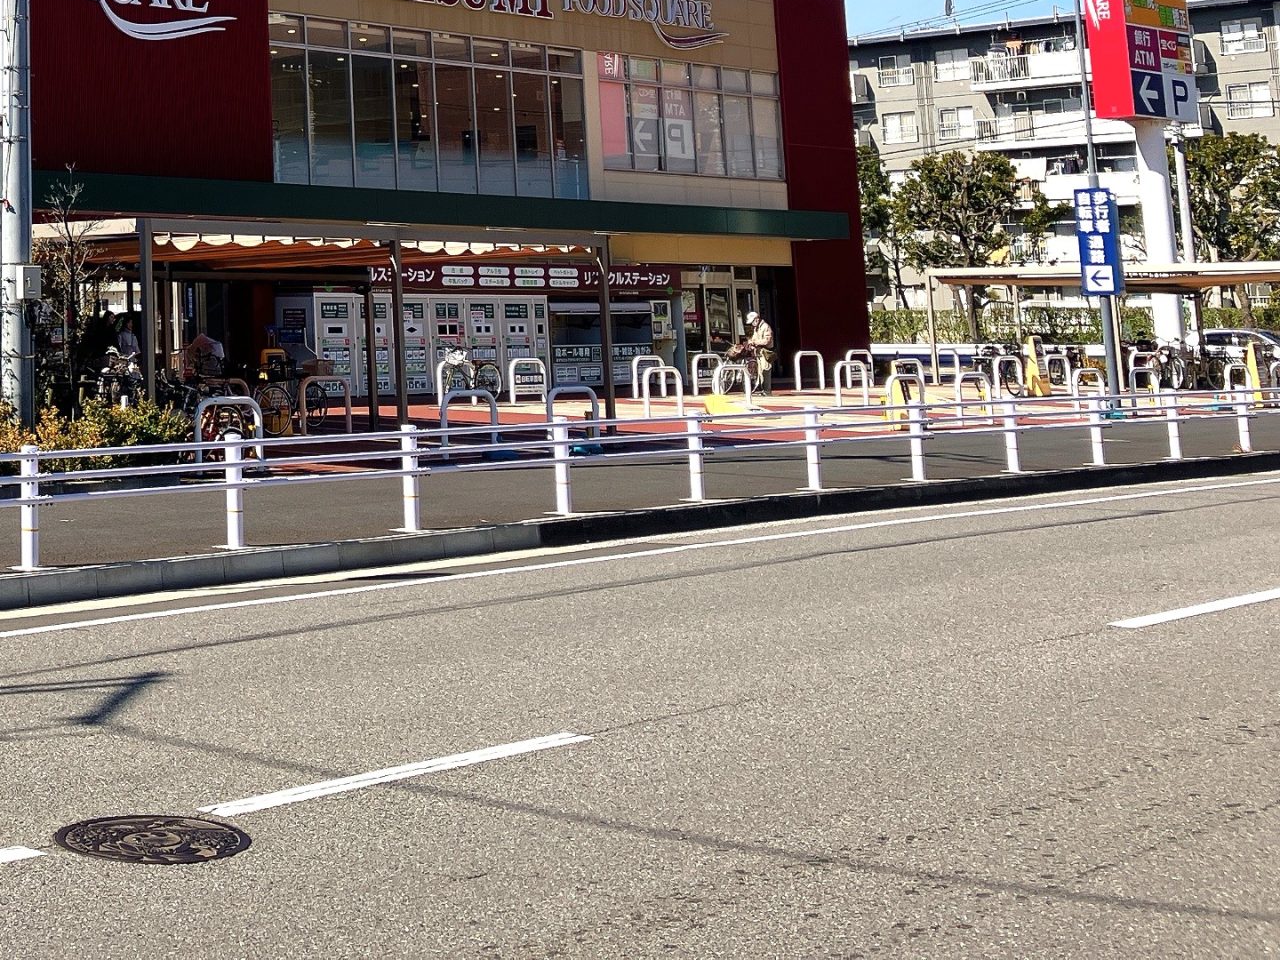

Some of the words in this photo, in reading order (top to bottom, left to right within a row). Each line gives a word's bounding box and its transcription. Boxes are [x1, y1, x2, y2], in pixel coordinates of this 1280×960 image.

[1134, 29, 1151, 47] 銀行
[1134, 50, 1155, 66] ATM
[1172, 79, 1188, 115] P
[584, 271, 671, 286] リクルステーション
